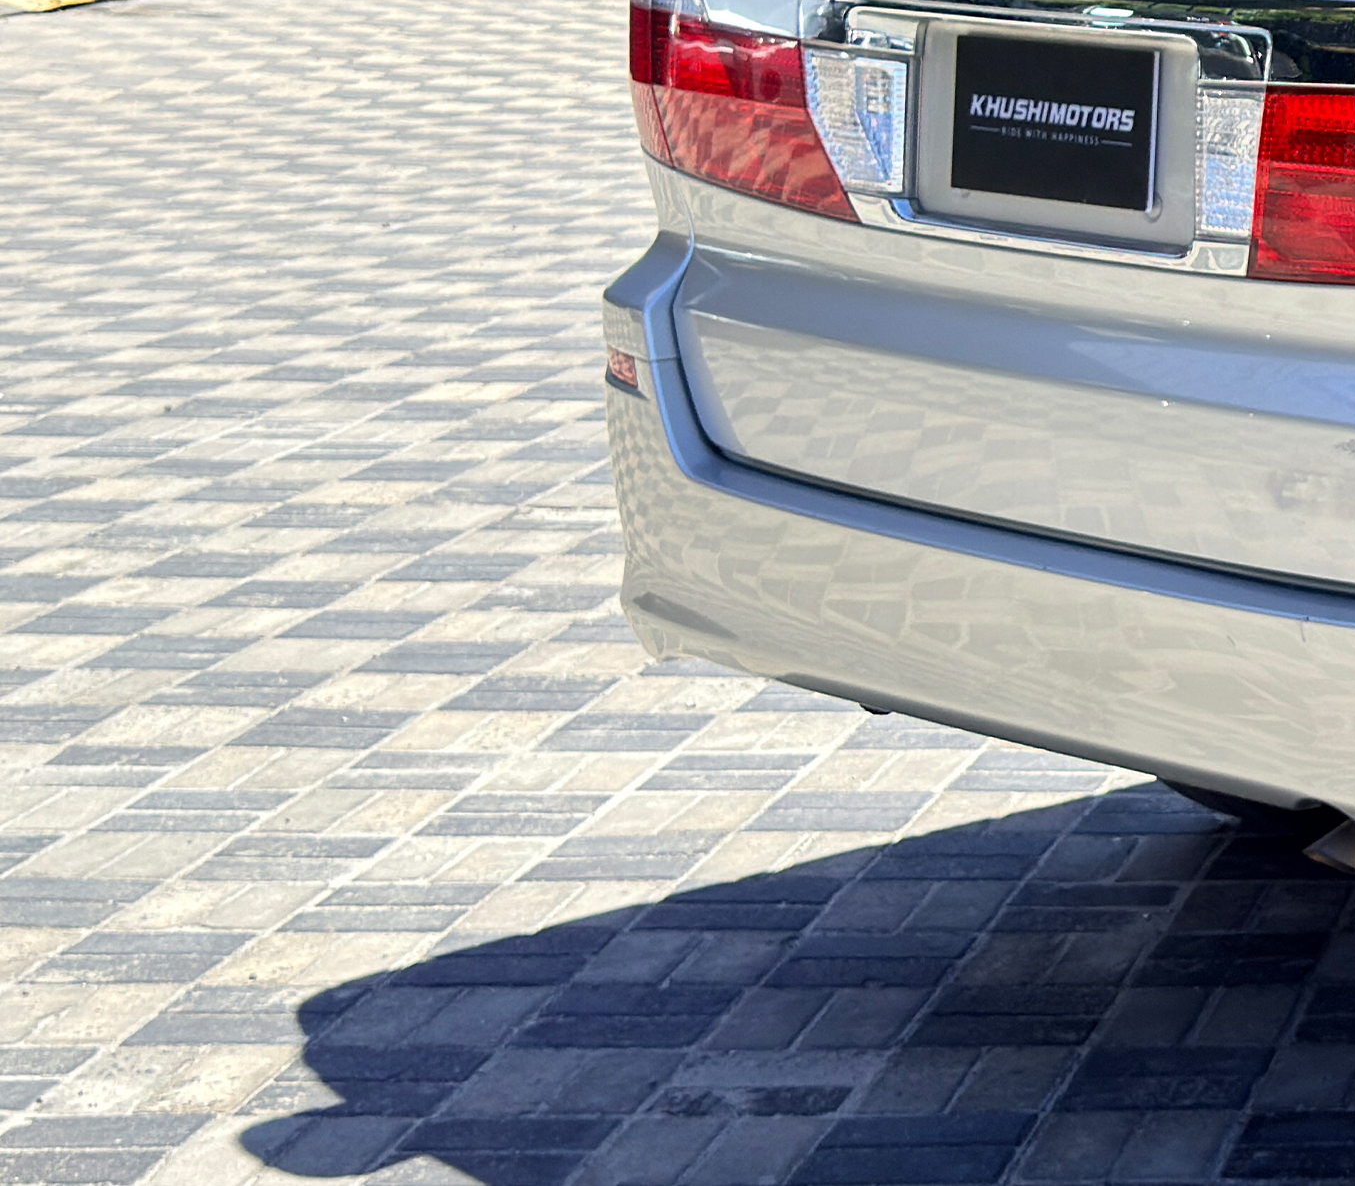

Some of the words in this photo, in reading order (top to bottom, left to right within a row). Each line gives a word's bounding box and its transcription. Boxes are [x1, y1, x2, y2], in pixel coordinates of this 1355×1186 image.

[1001, 126, 1022, 139] RIDE
[1025, 129, 1048, 140] WITH
[1051, 132, 1100, 146] HAPPINESS
